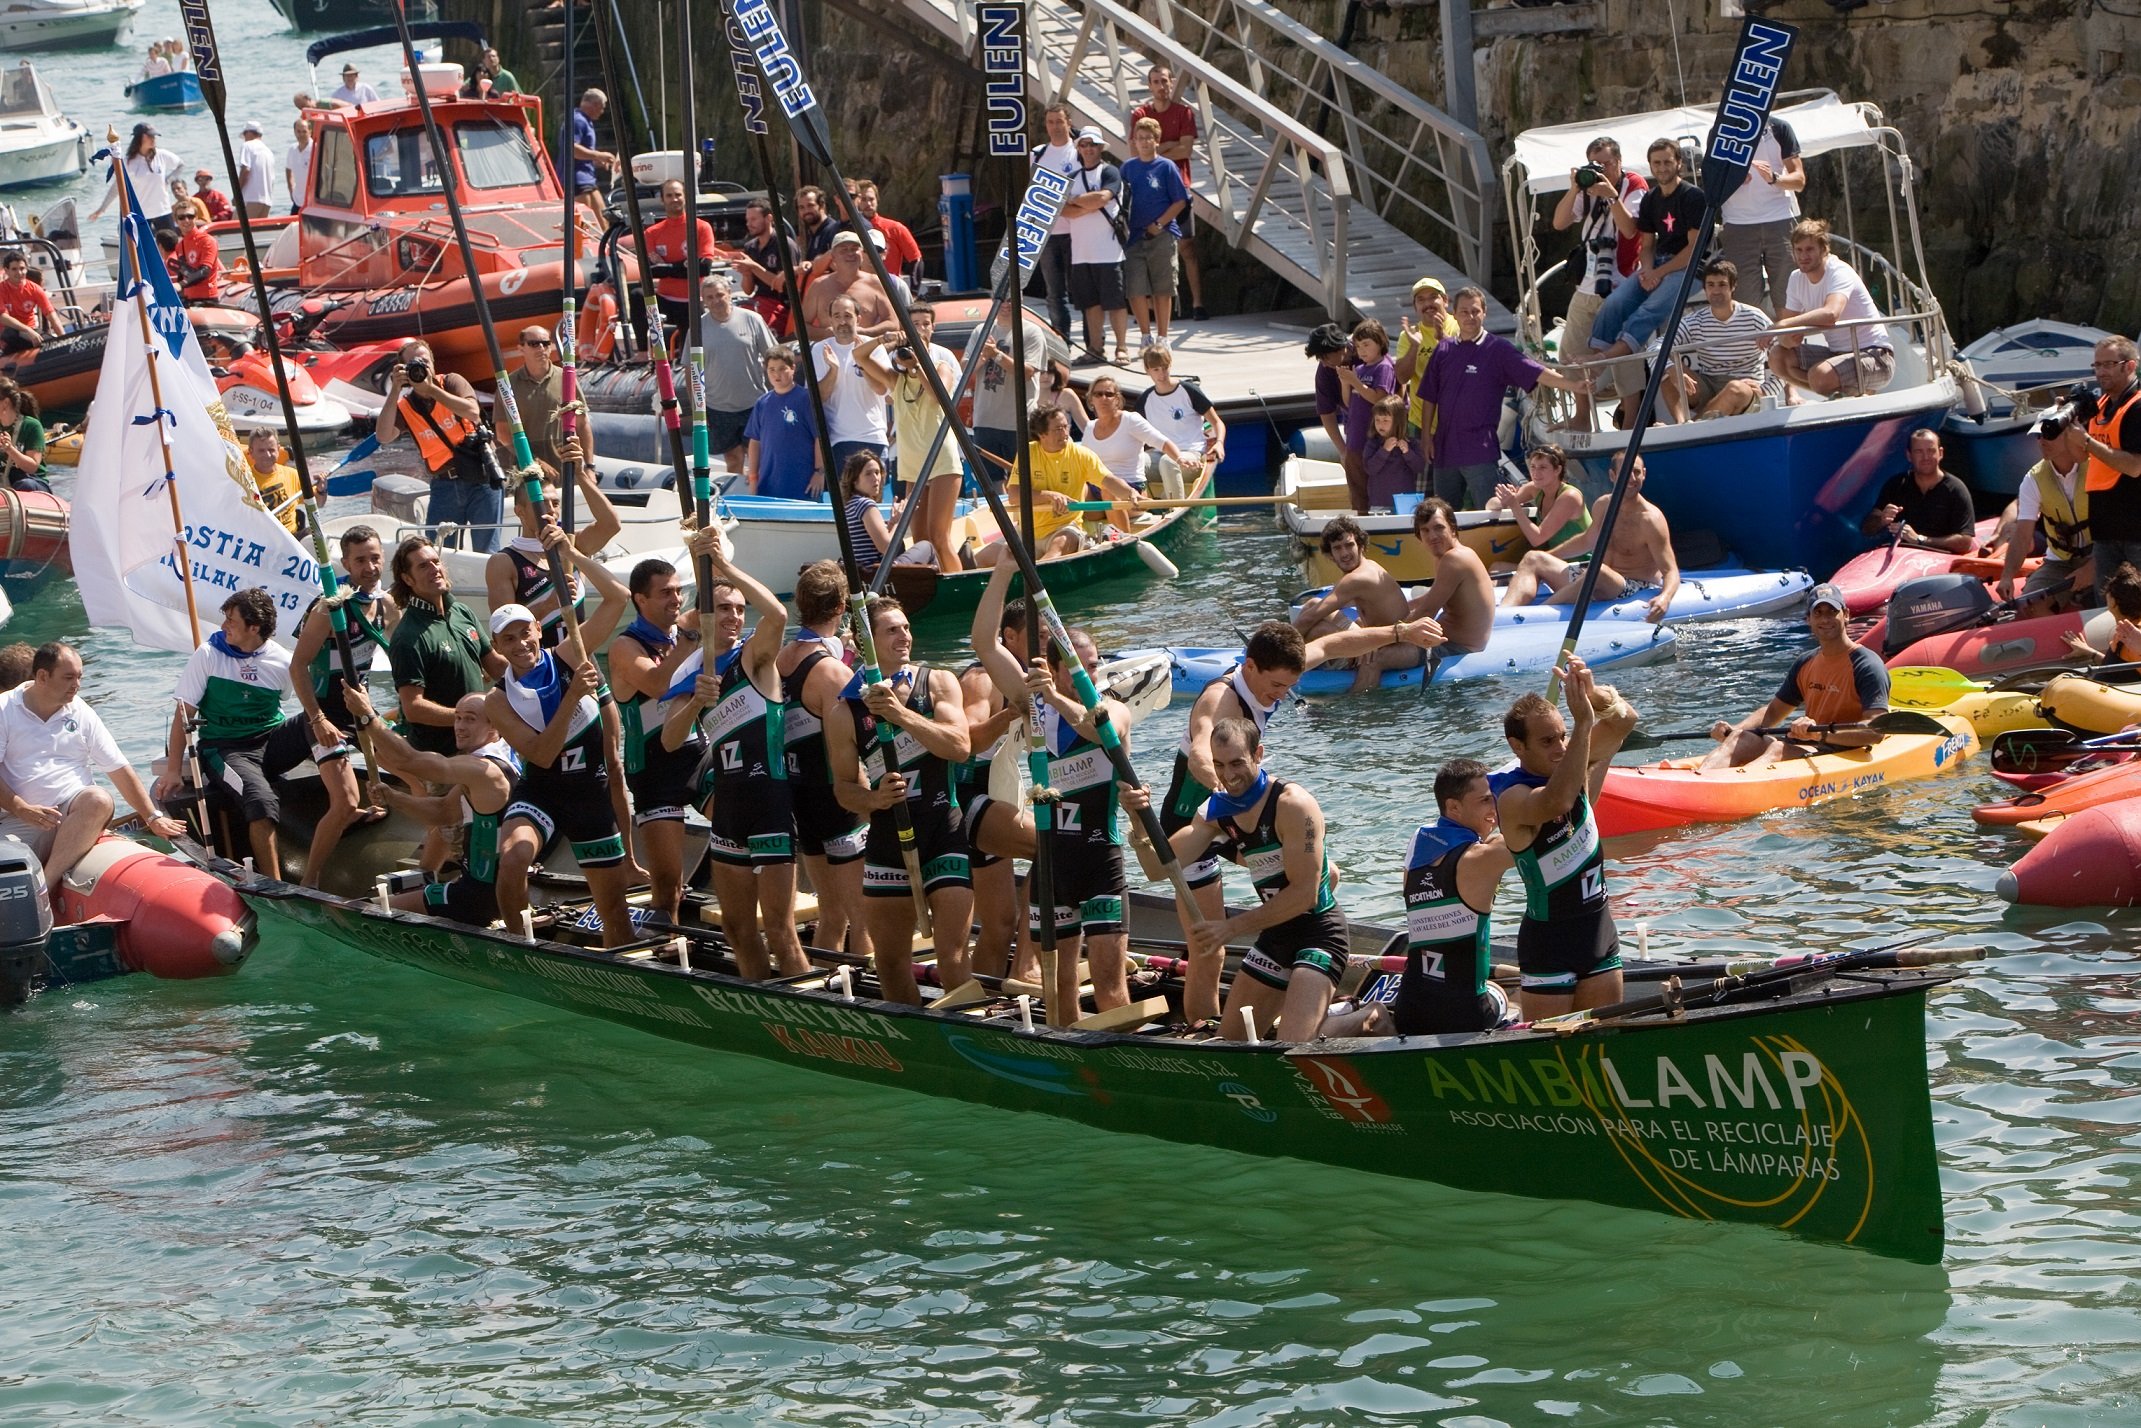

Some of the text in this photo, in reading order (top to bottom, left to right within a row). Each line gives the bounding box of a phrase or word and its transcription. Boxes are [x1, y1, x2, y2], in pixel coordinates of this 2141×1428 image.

[183, 0, 220, 81] LEN
[982, 8, 1027, 156] EULEN
[1711, 23, 1791, 166] EULEN
[999, 167, 1069, 270] EULEN
[1910, 601, 1944, 615] YAMAHA
[704, 694, 747, 732] MBILAMP
[1049, 757, 1095, 782] BILAMP
[1799, 771, 1885, 800] OCEAN KAYAK
[582, 843, 620, 858] KAIK
[750, 837, 783, 850] AIKU
[925, 859, 962, 878] AIKU
[1082, 901, 1114, 917] AIKU
[1409, 888, 1444, 904] DECATHLON
[1438, 920, 1451, 931] DEL
[1452, 914, 1476, 926] NORTE
[760, 1021, 904, 1072] KAIKU
[1449, 1109, 1836, 1148] ASOCIACIÓN PARA EL RECICLAJE
[1668, 1147, 1841, 1181] DE LÁMPARAS
